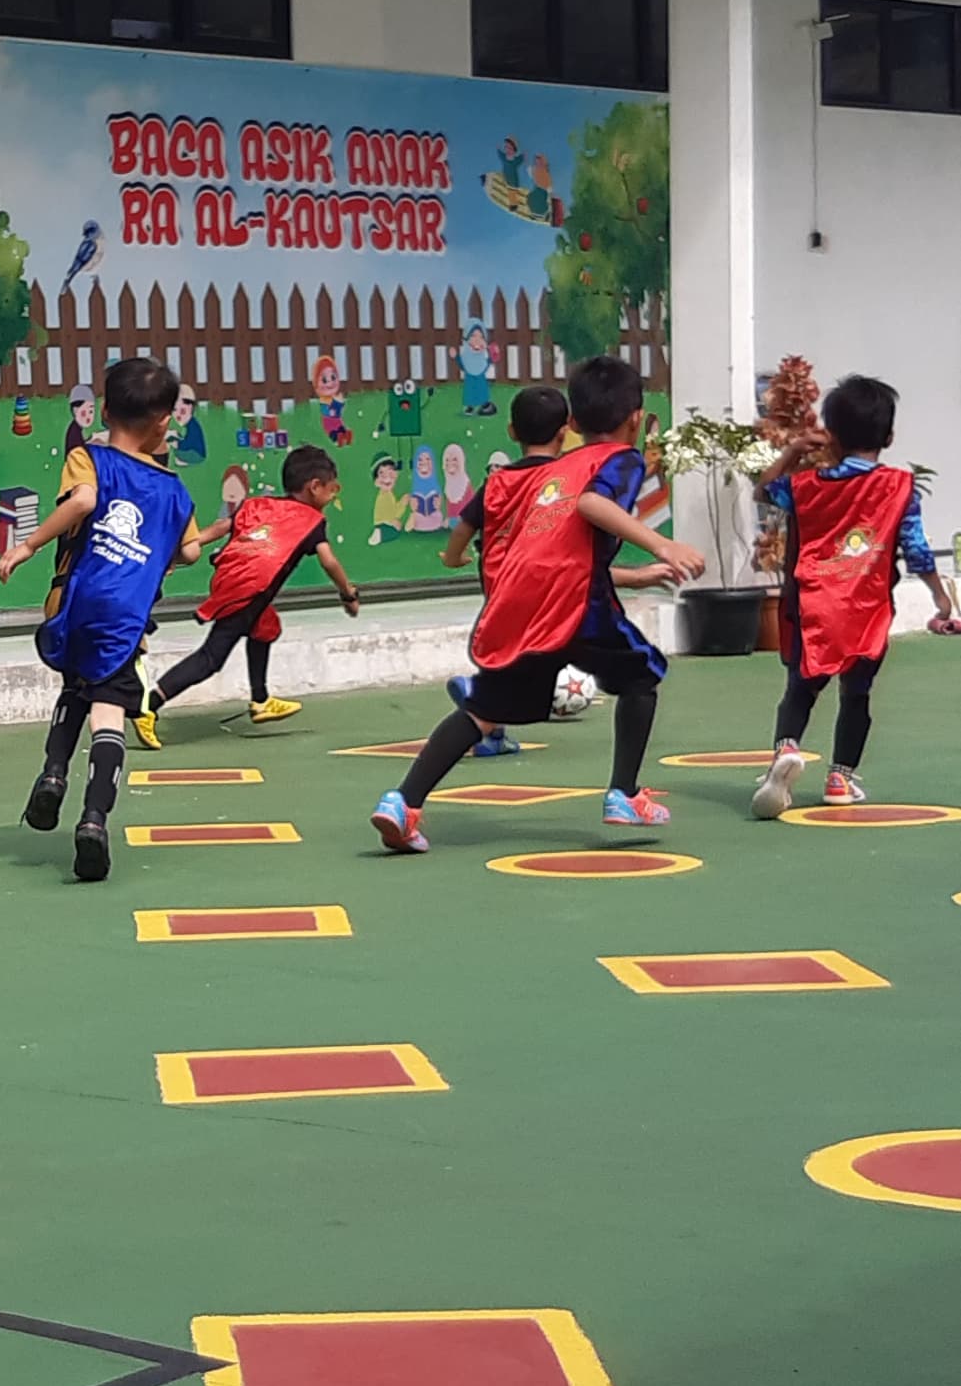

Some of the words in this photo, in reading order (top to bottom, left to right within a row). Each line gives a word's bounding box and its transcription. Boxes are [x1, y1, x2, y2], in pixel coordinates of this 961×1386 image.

[107, 113, 226, 179] BACA
[240, 120, 333, 184] ASIK
[346, 128, 451, 191] ANAK
[121, 183, 181, 247] RA
[194, 186, 447, 254] AL-KAUTSAR
